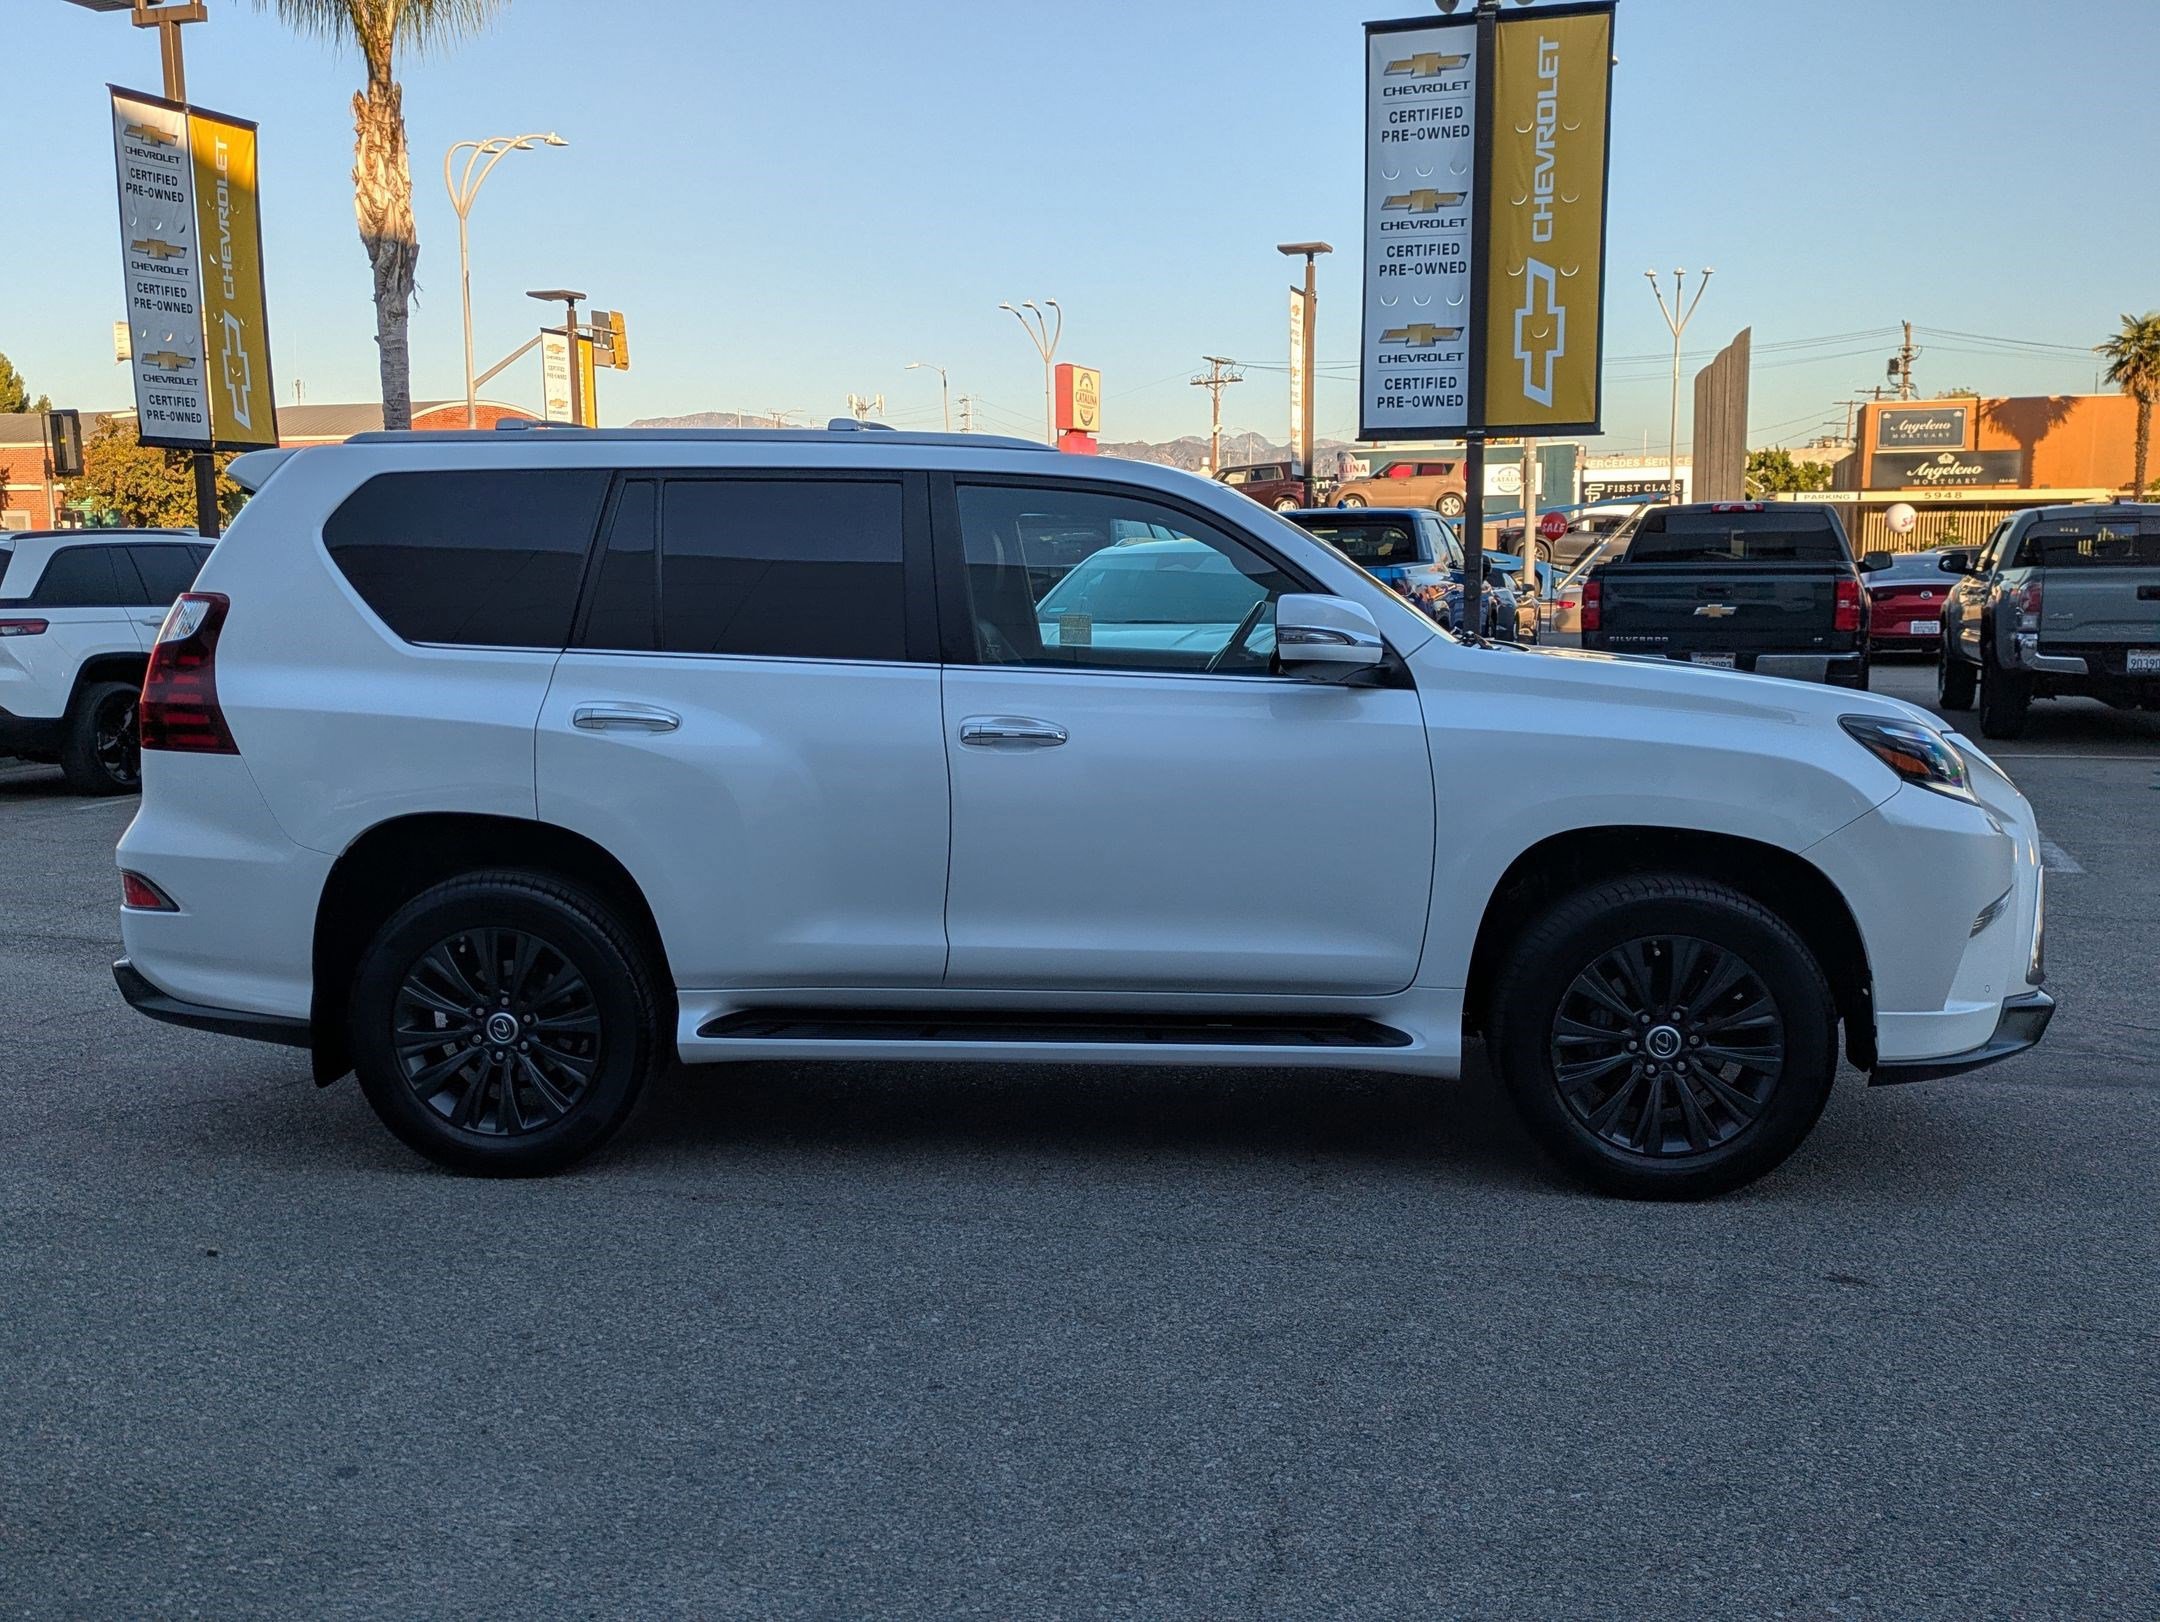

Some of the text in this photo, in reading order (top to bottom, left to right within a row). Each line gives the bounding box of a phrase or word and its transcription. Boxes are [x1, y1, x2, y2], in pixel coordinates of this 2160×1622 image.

[1383, 80, 1471, 97] CHEVROLET
[1388, 105, 1463, 124] CERTIFIED
[1381, 124, 1470, 143] PRE-OWNED
[1532, 36, 1560, 243] CHEVROLET
[125, 146, 181, 164] CHEVROLET
[130, 167, 178, 187] CERTIFIED
[126, 183, 184, 203] PRE-OWNED
[215, 135, 235, 300] CHEVROLET
[1380, 218, 1468, 231] CHEVROLET
[1386, 242, 1461, 259] CERTIFIED
[131, 261, 190, 276] CHEVROLET
[1379, 260, 1467, 277] PRE-OWNED
[136, 282, 187, 298] CERTIFIED
[134, 297, 193, 314] PRE-OWNED
[1378, 352, 1465, 364] CHEVROLET
[143, 373, 199, 387] CHEVROLET
[1384, 376, 1457, 391] CERTIFIED
[149, 394, 197, 408] CERTIFIED
[1377, 394, 1464, 409] PRE-OWNED
[146, 409, 202, 424] PRE-OWNED
[1890, 419, 1952, 434] Angeleno
[1645, 457, 1692, 467] SERVCE
[1906, 461, 1984, 480] Angeleno
[1606, 484, 1641, 493] FIRST
[1924, 491, 1962, 499] 5948
[1542, 522, 1566, 533] SALE
